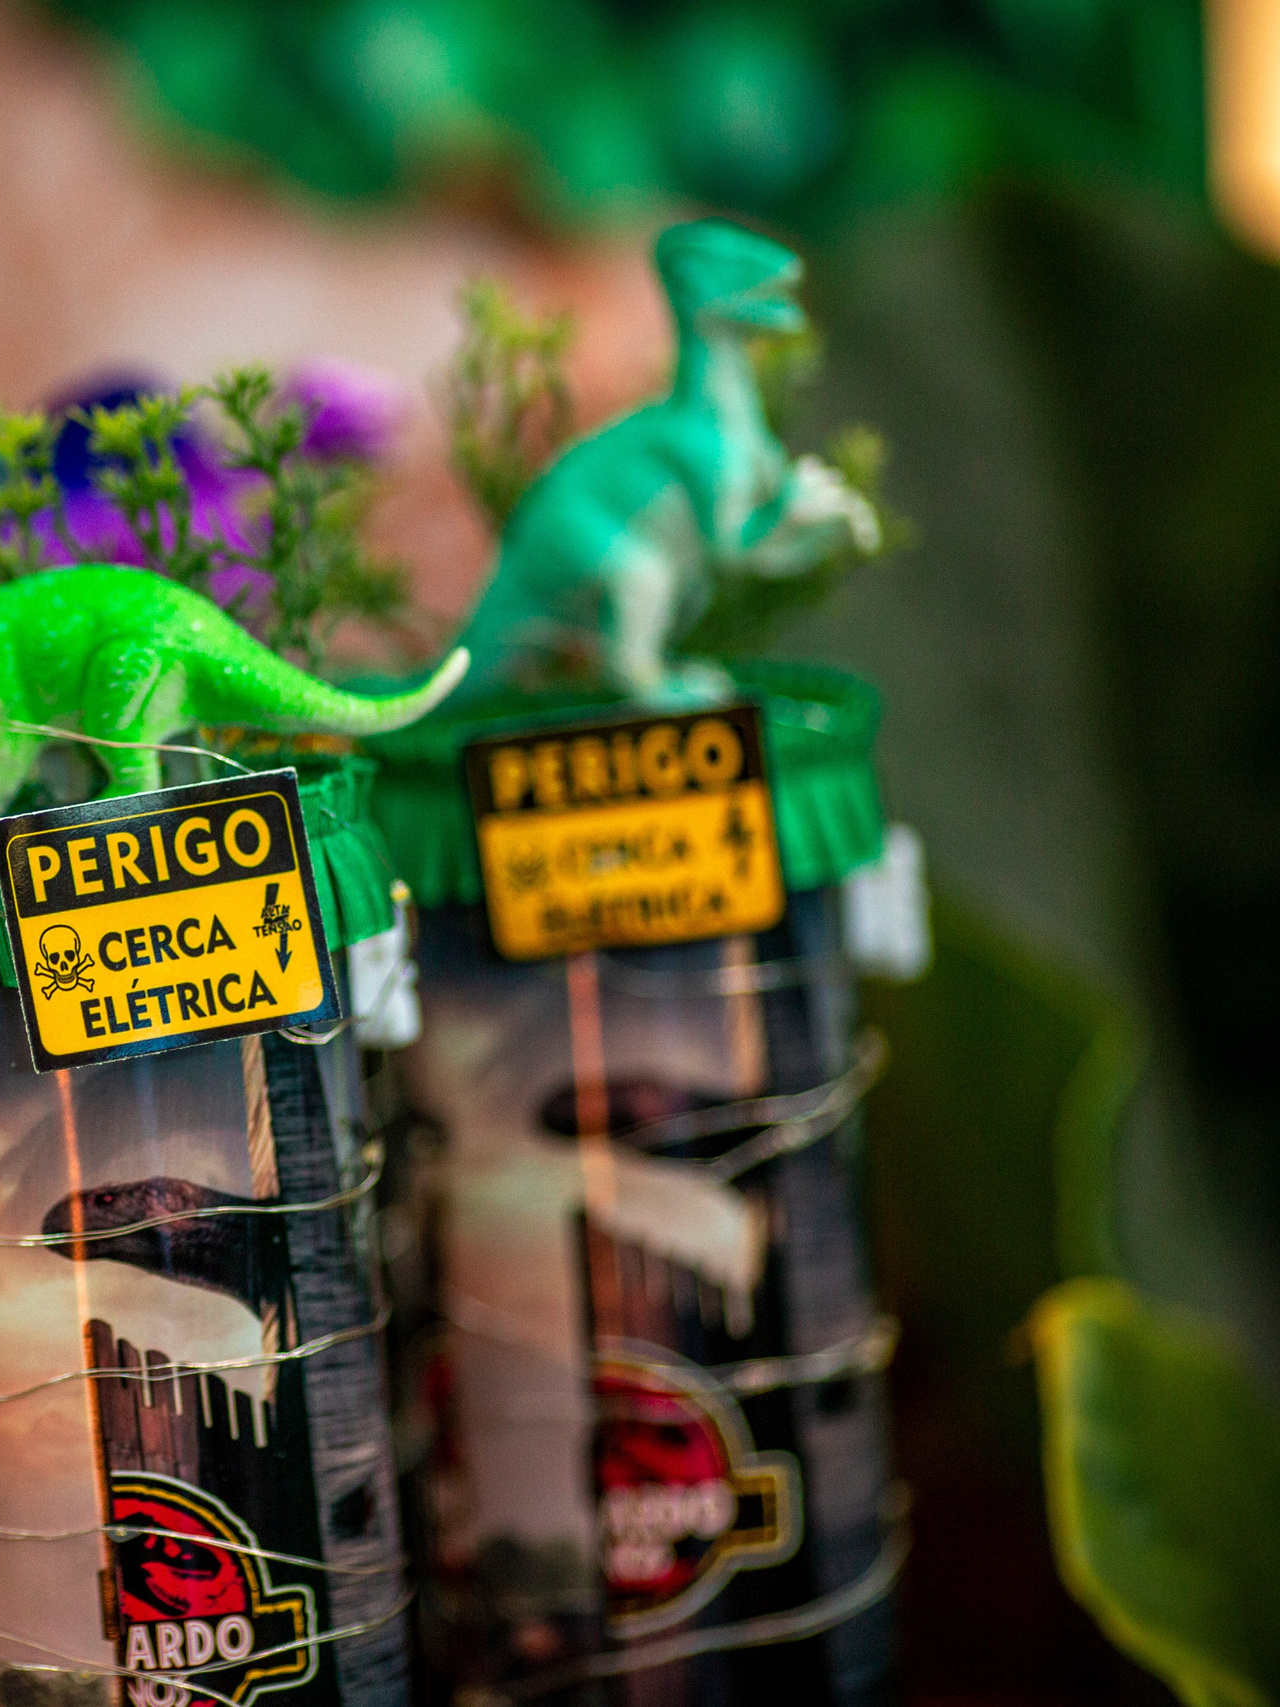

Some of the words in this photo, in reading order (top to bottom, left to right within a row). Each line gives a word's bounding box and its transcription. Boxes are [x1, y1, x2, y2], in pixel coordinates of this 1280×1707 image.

[488, 717, 744, 810] PERIGO
[26, 808, 271, 903] PERIGO
[98, 914, 237, 972] CERCA
[80, 969, 278, 1038] ELÉTRICA
[126, 1614, 255, 1670] ARDO
